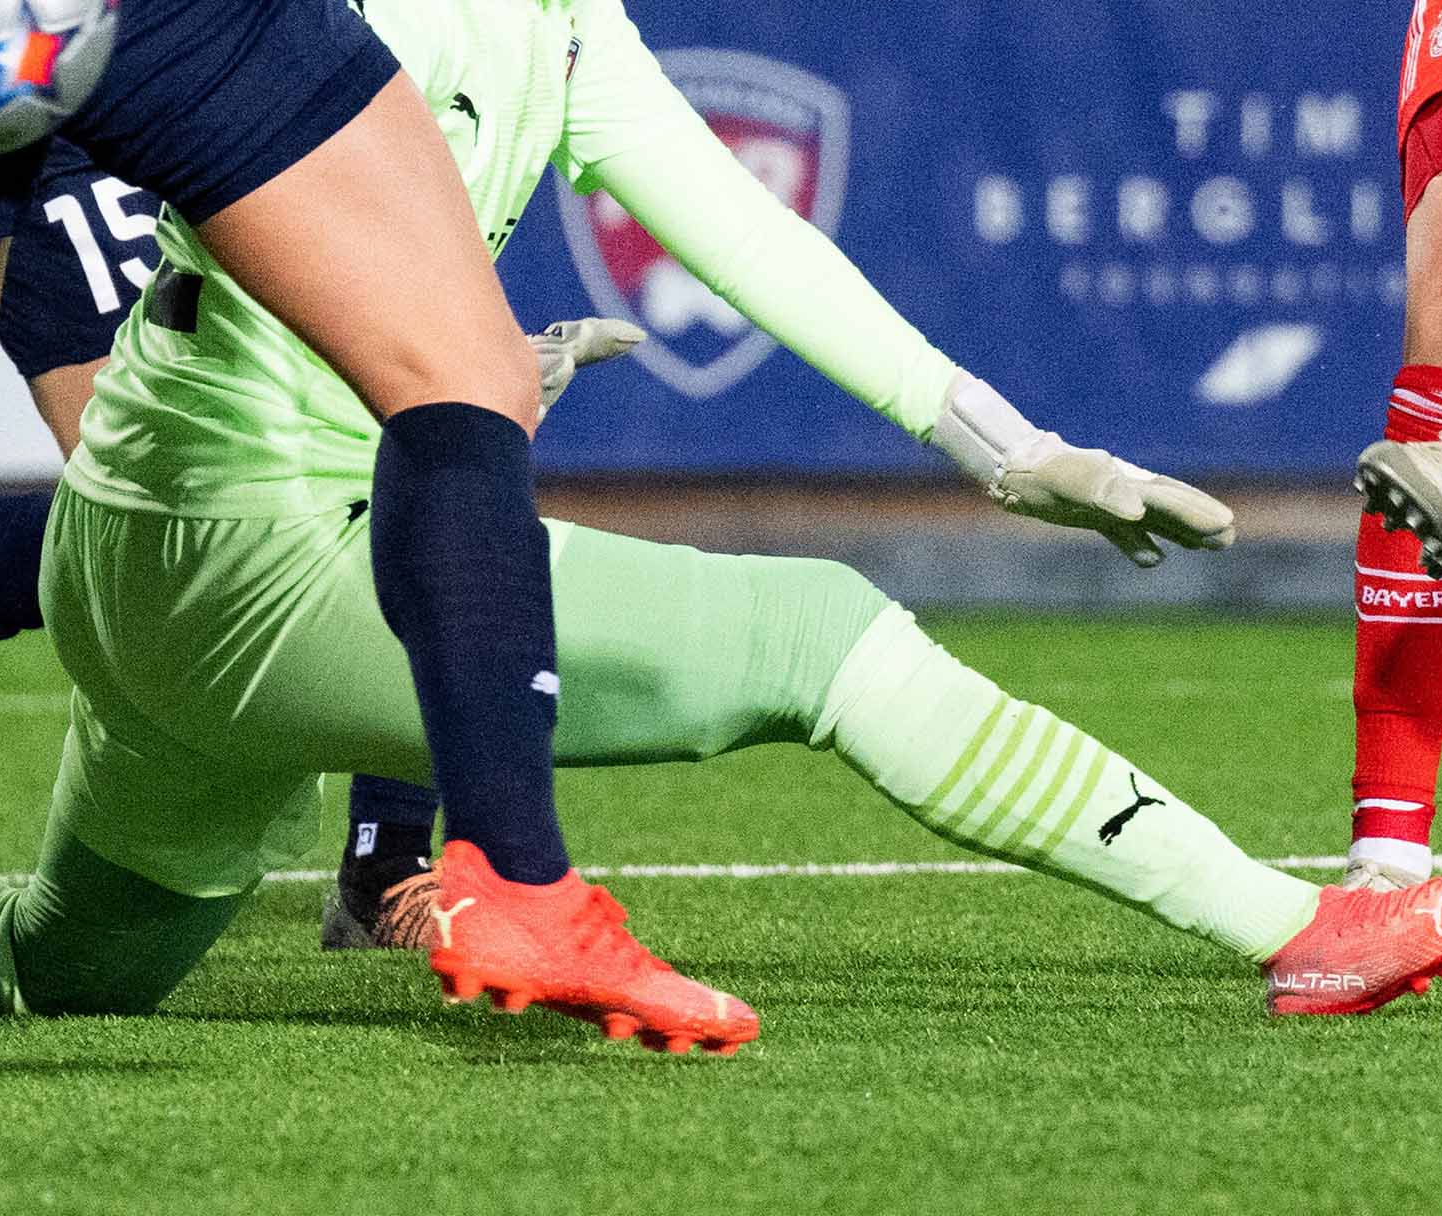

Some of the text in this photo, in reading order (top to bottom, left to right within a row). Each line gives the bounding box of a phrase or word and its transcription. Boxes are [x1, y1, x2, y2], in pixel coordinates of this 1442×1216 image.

[1166, 90, 1360, 158] TIM
[43, 176, 159, 315] 15
[1273, 971, 1367, 991] ULTRA
